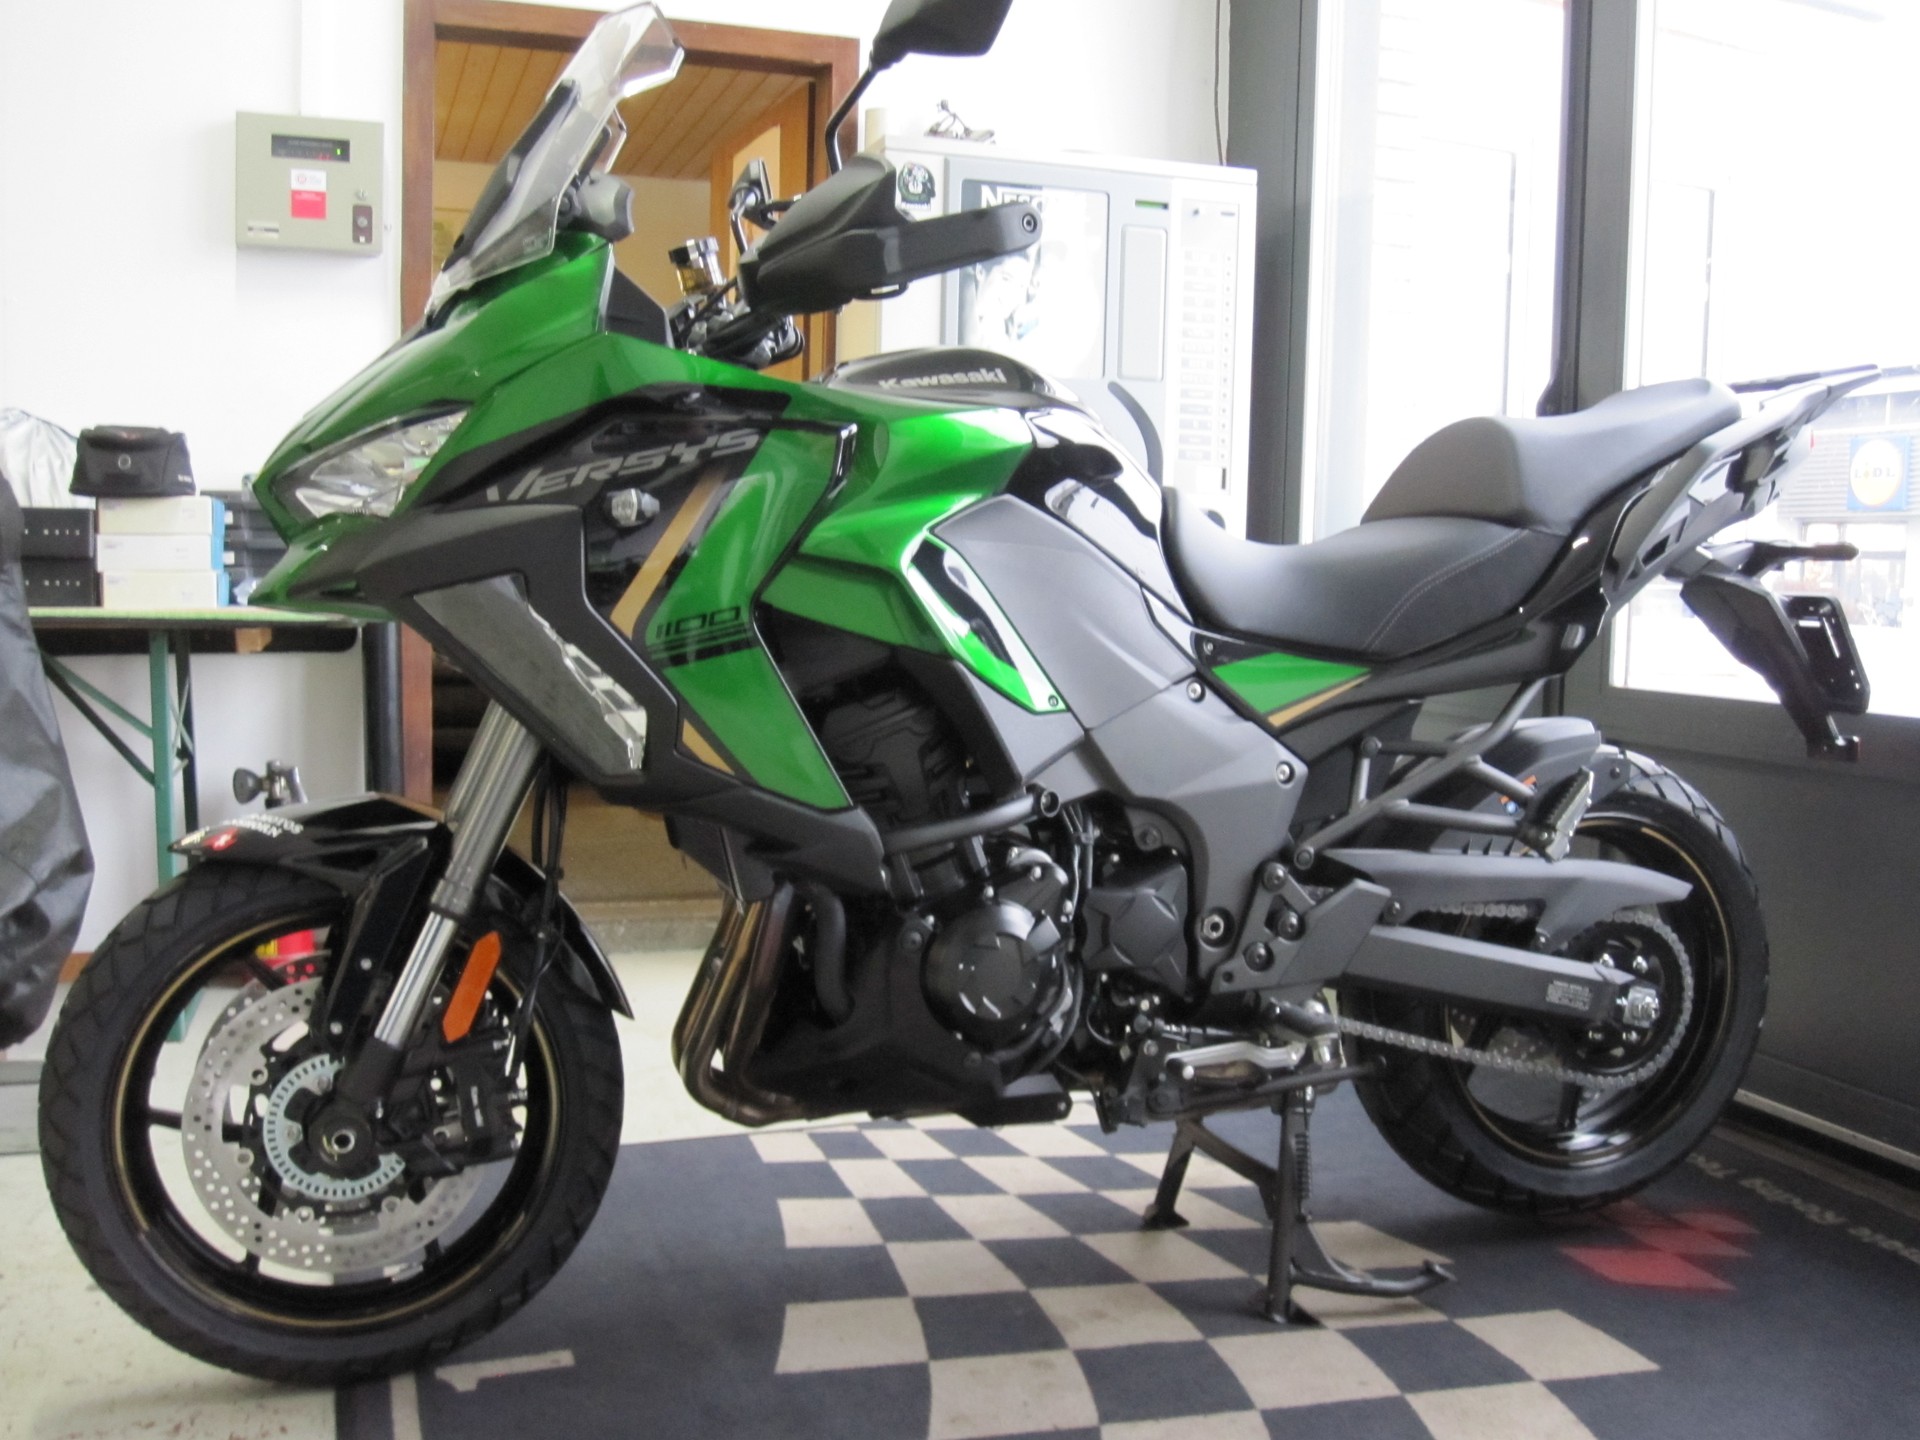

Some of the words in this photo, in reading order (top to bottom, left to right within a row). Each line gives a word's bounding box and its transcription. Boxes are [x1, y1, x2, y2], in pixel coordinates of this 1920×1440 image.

[877, 367, 1007, 390] Kawasaki
[486, 428, 760, 501] VERSYS
[656, 606, 741, 640] 1100
